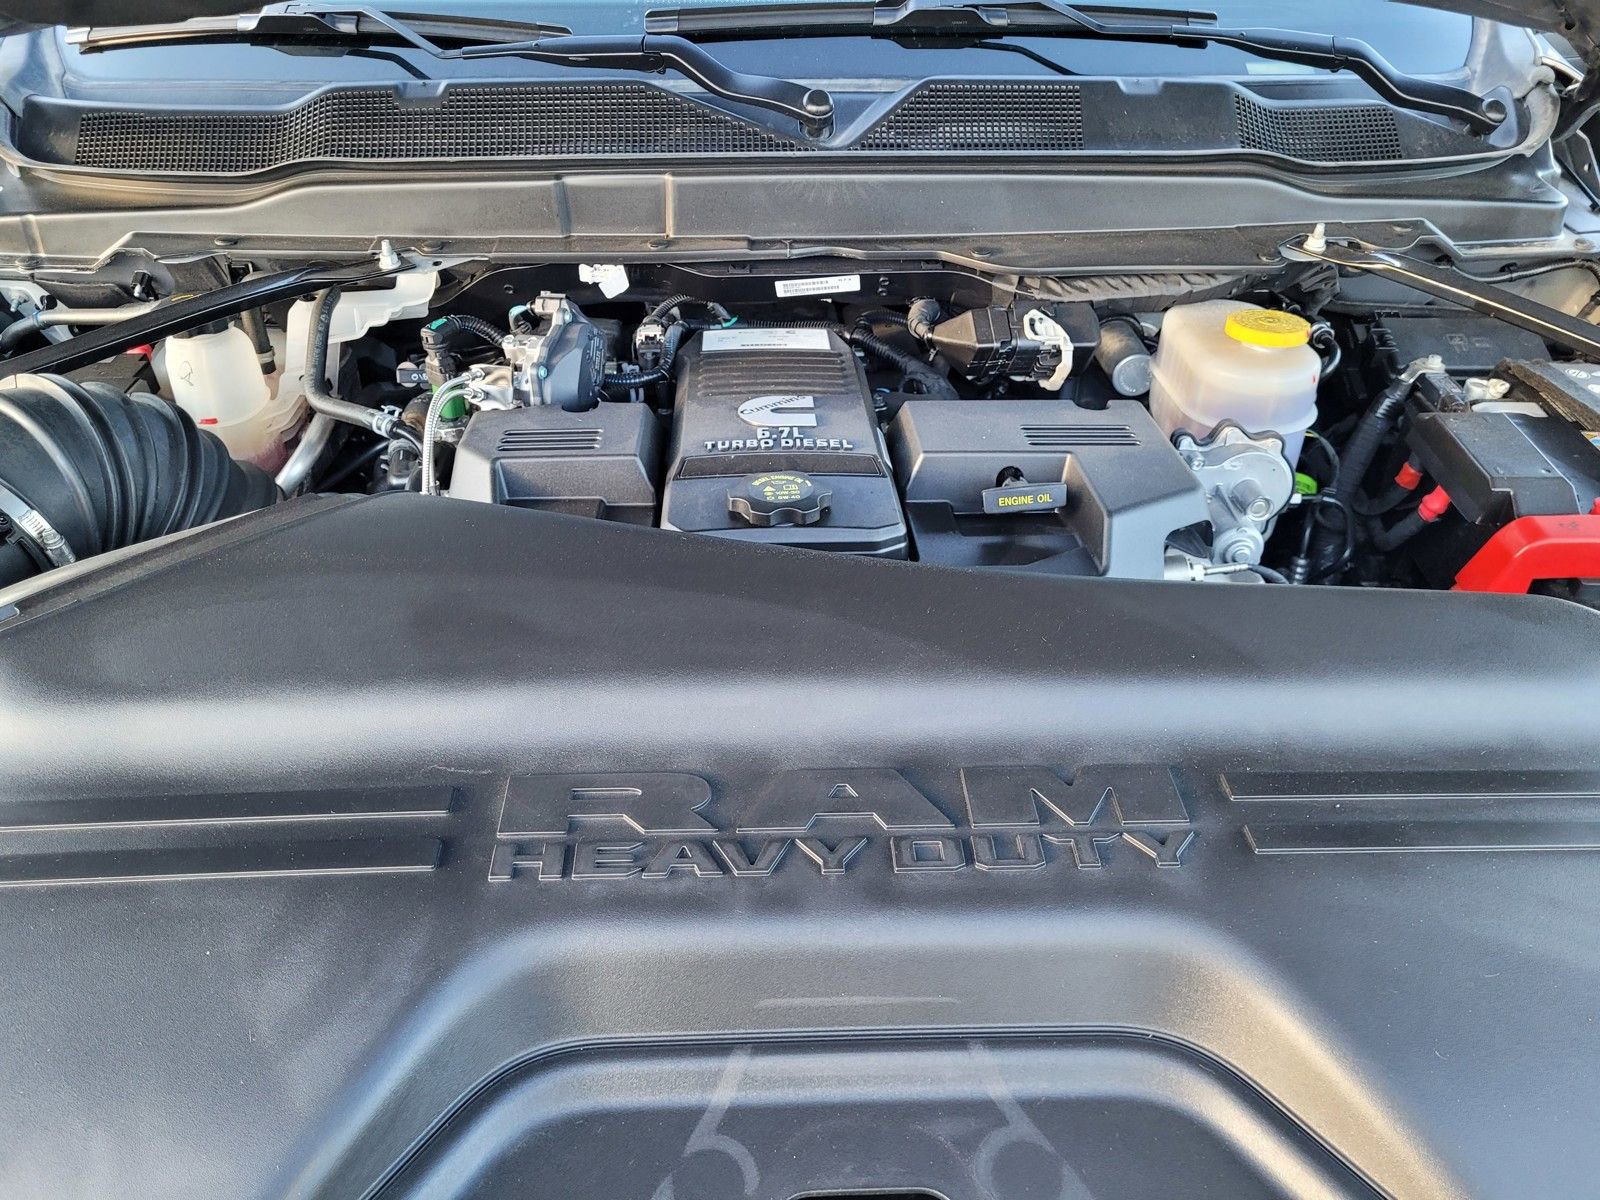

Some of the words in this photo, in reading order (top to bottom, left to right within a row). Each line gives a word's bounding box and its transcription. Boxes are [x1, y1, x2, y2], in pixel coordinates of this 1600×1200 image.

[757, 427, 804, 440] 6.7L
[704, 439, 775, 451] TURBO
[780, 438, 854, 450] DIESEL
[998, 495, 1034, 507] ENGINE
[1036, 493, 1053, 503] OIL
[496, 763, 1190, 838] RAM
[488, 837, 869, 882] HEAVY
[889, 830, 1195, 874] DUTY
